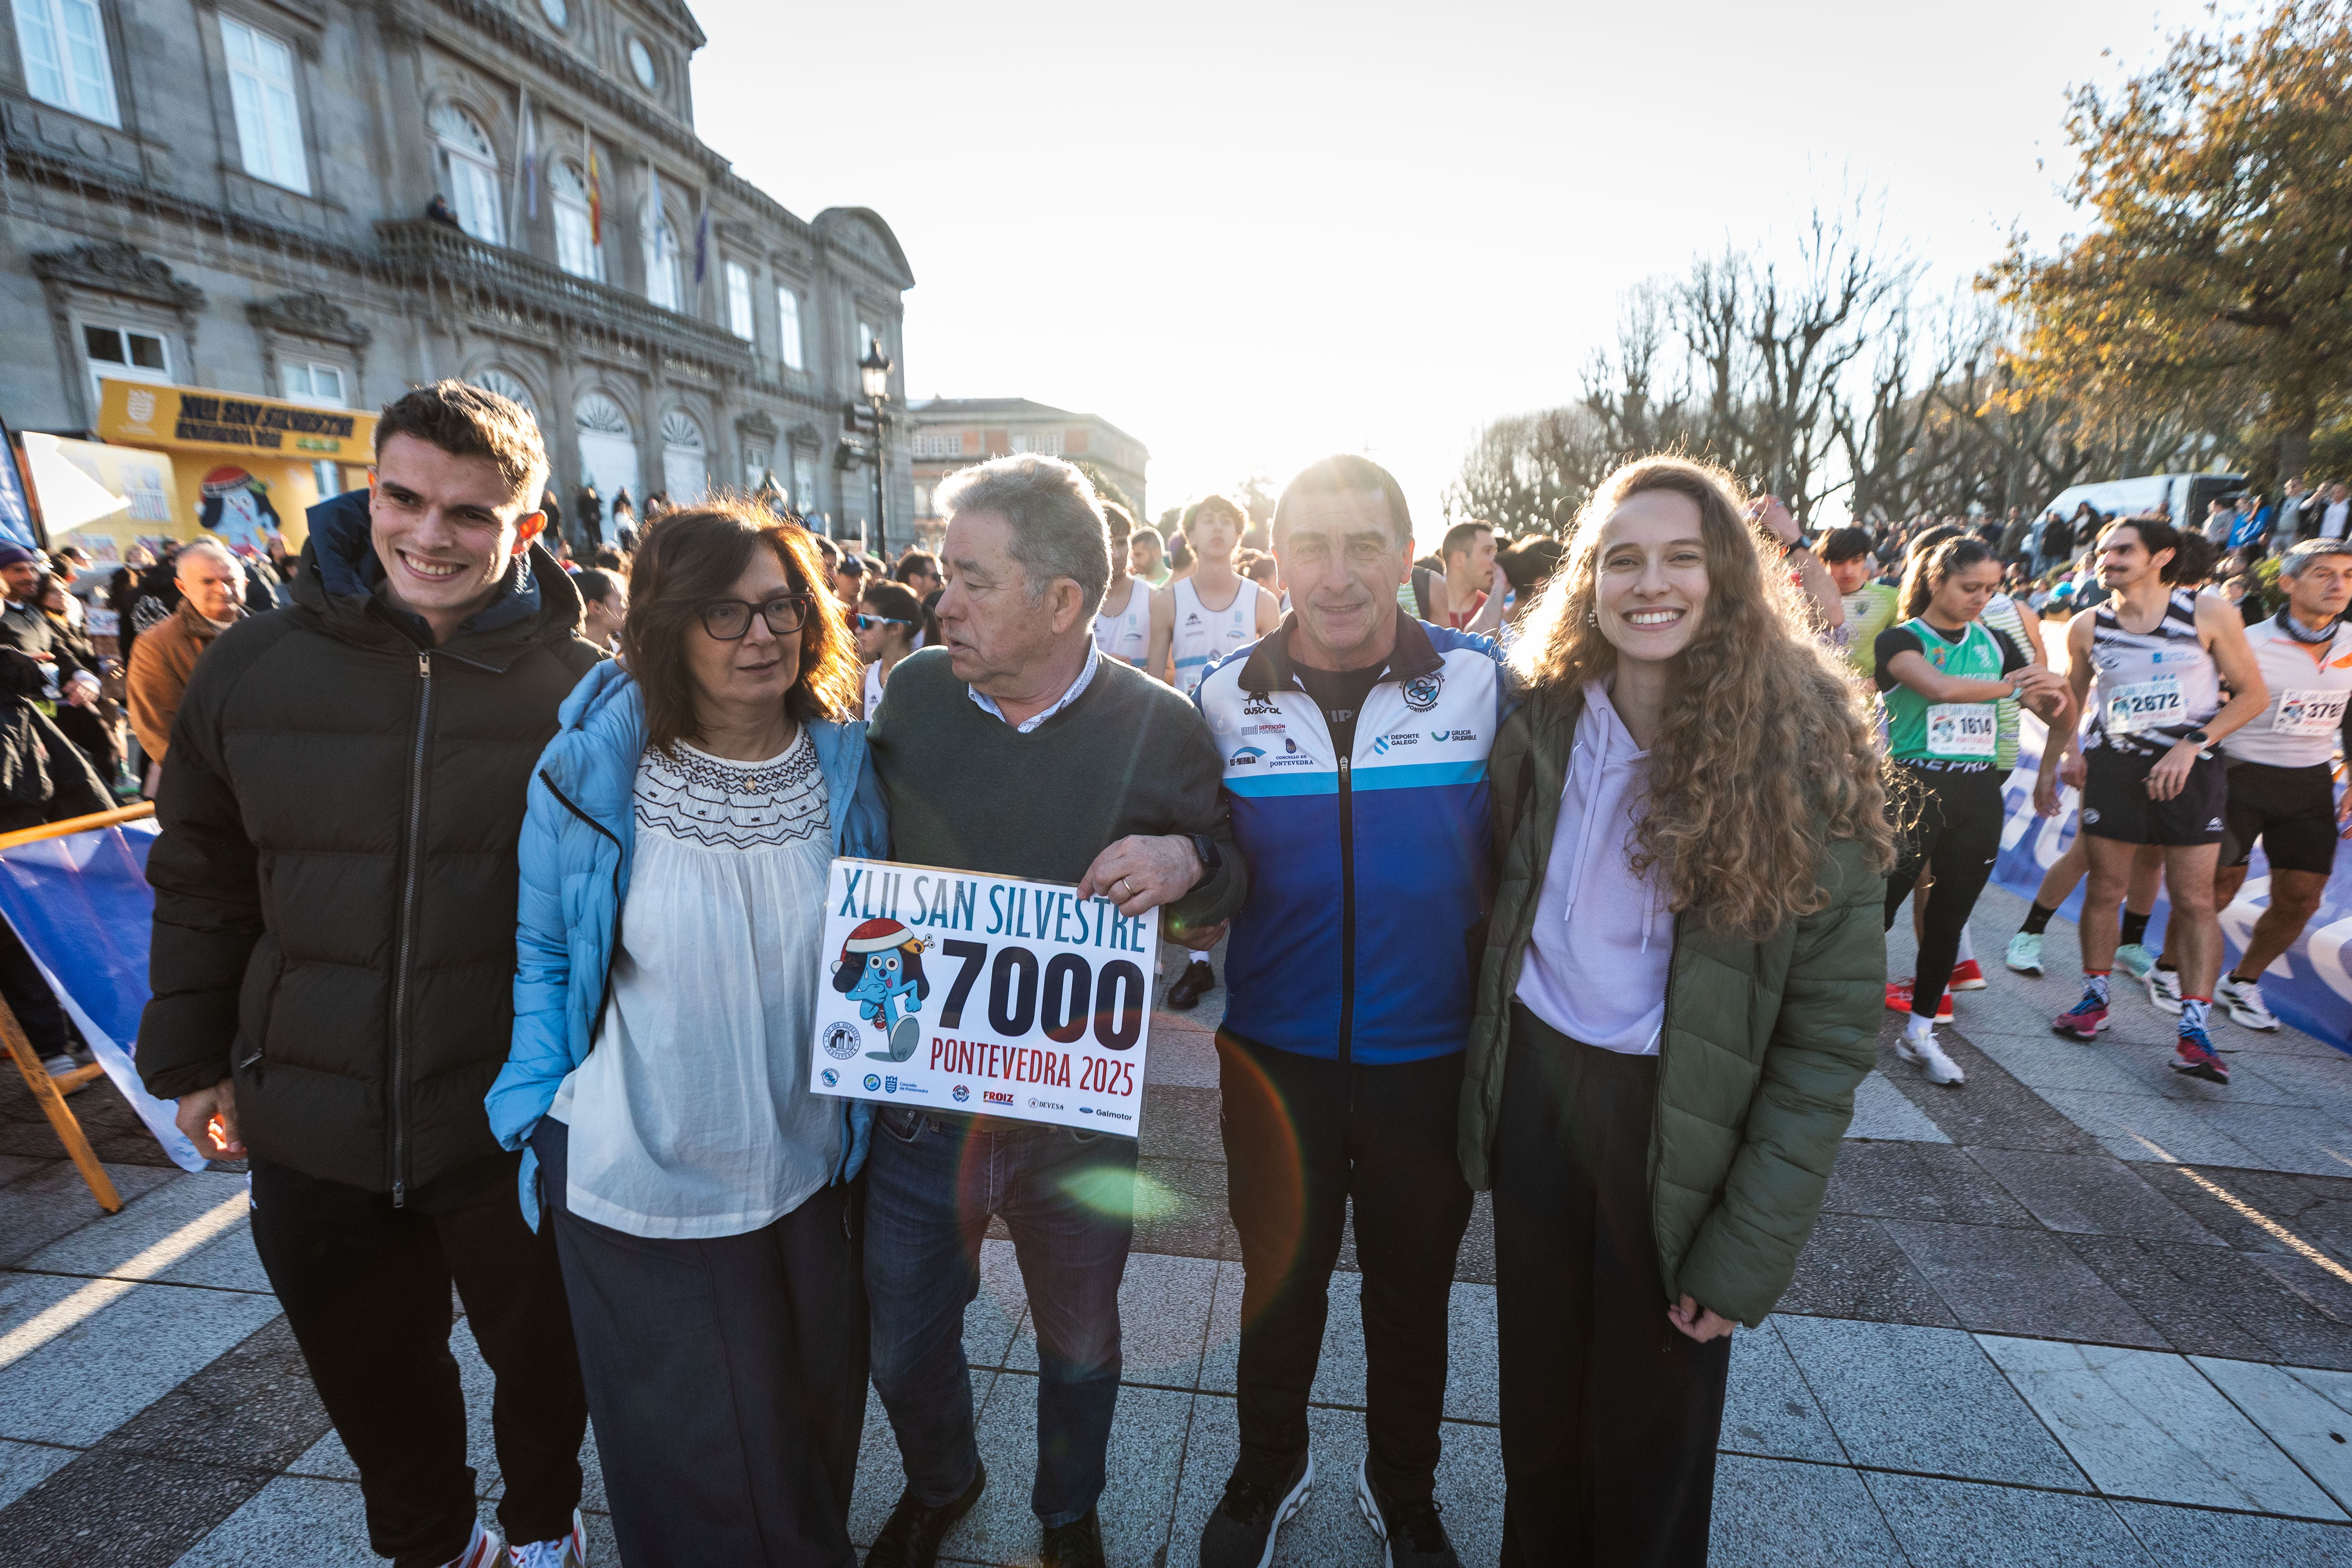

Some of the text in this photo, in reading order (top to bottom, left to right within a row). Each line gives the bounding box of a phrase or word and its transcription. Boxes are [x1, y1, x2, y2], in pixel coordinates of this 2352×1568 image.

[1406, 702, 1439, 713] PONTEVEDRA
[2132, 692, 2180, 712] 2672
[1244, 706, 1282, 715] austral
[1960, 716, 1993, 735] 1614
[1270, 760, 1314, 768] PONTEVEDRA
[838, 867, 1146, 953] XLII SAN SILVESTRE
[939, 938, 1145, 1051] 7000
[930, 1038, 1135, 1097] PONTEVEDRA 2025
[984, 1091, 1014, 1103] FROIZ
[1039, 1101, 1064, 1111] DEVESA
[1096, 1109, 1132, 1121] Galmotor
